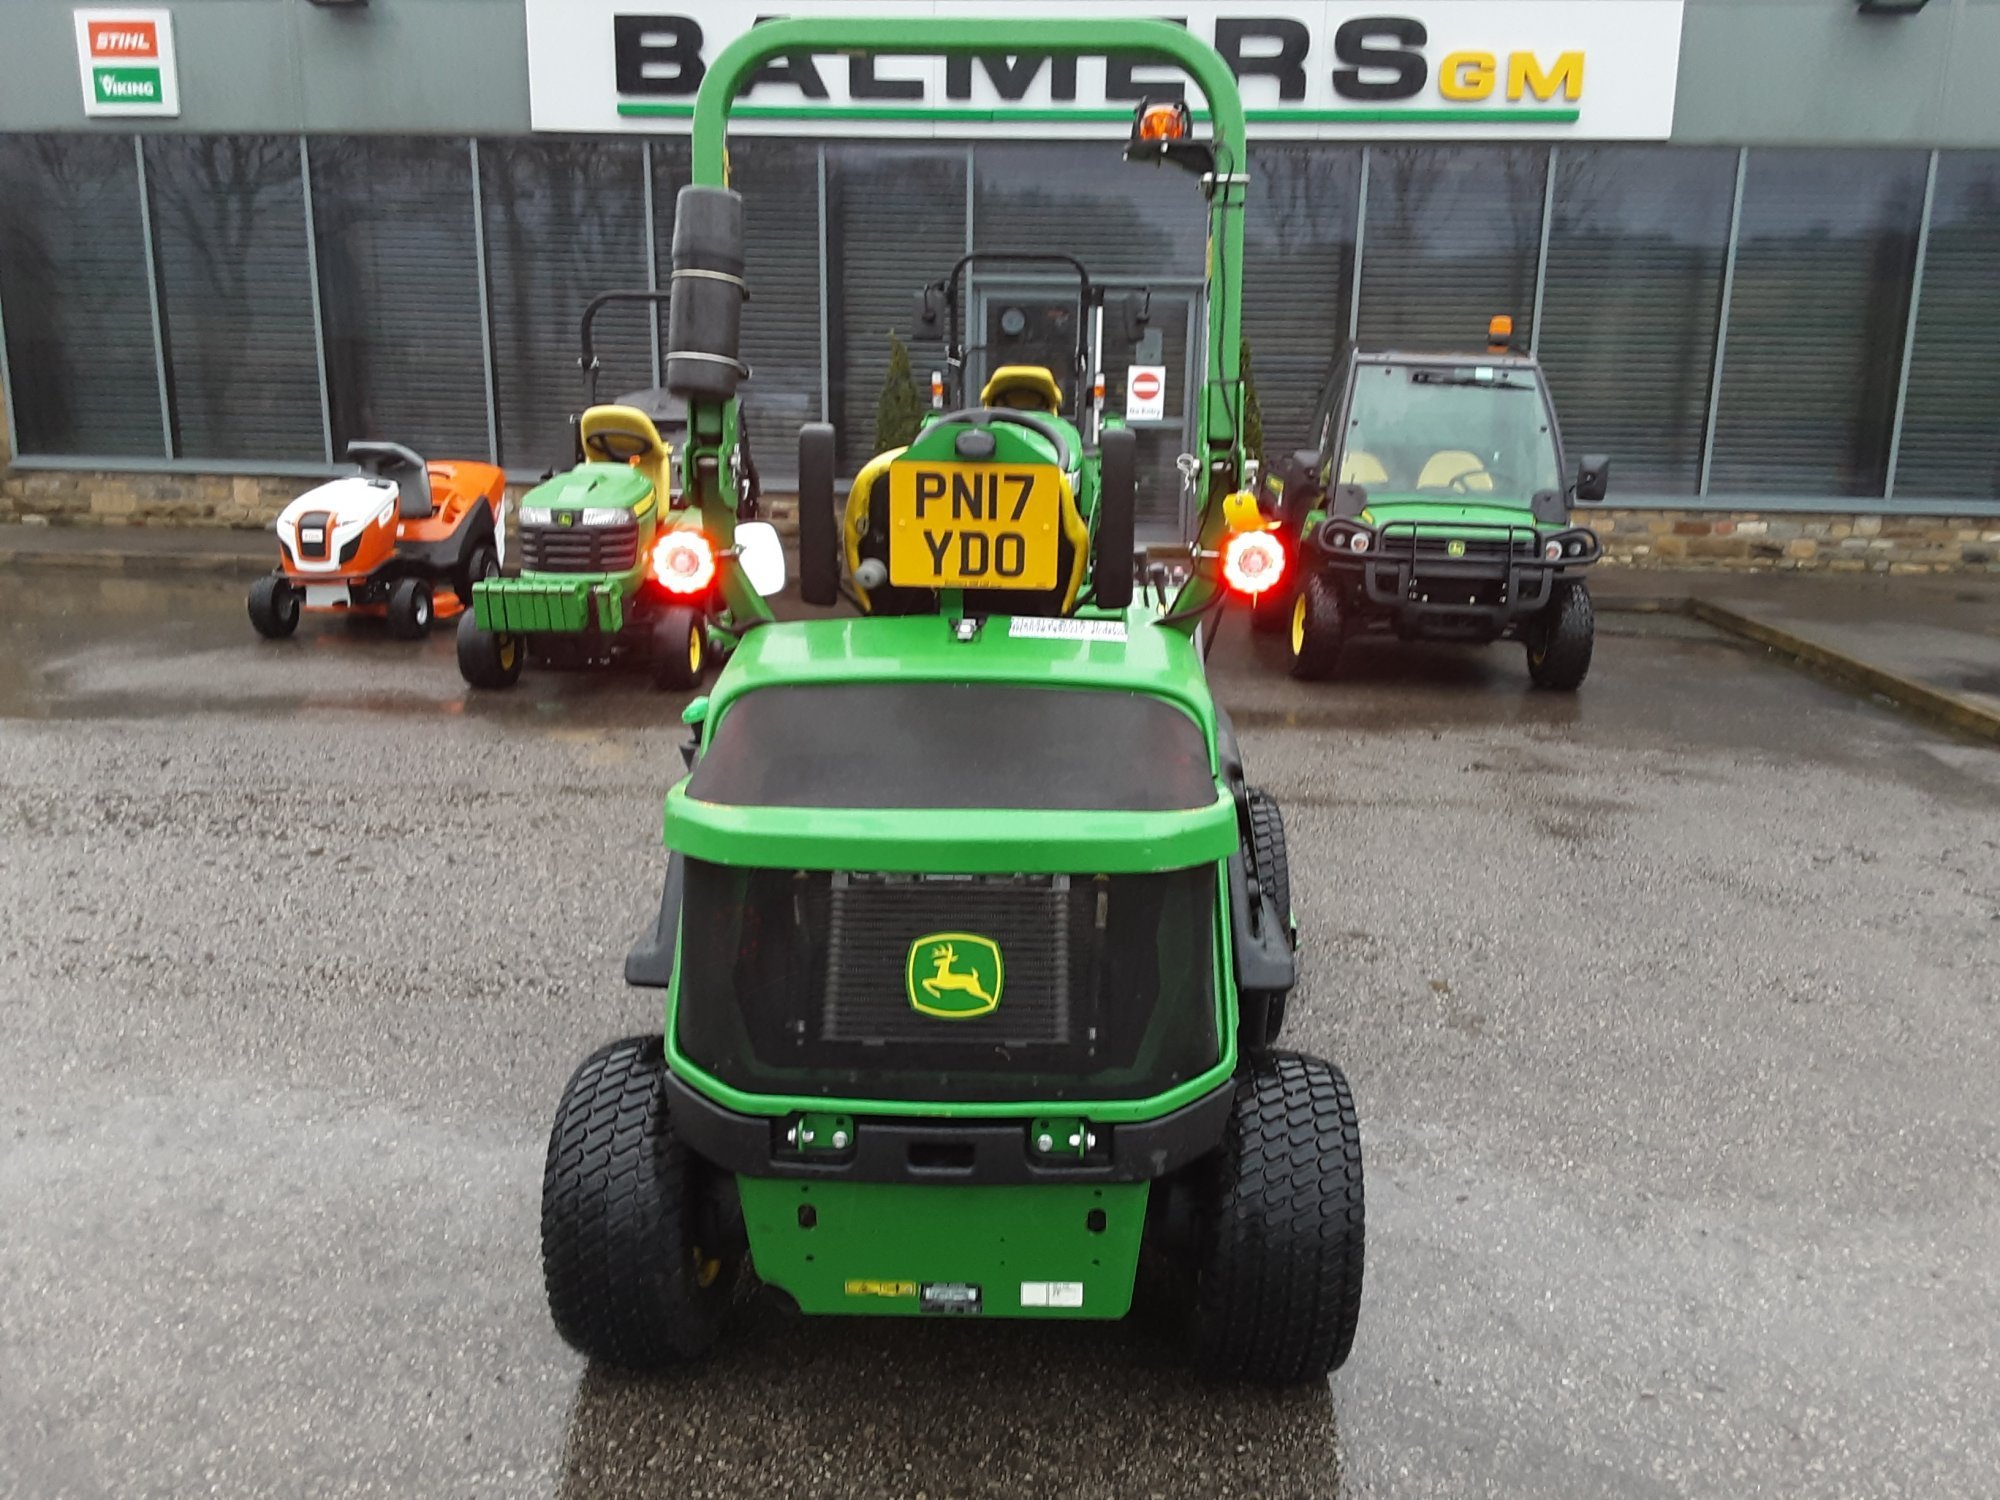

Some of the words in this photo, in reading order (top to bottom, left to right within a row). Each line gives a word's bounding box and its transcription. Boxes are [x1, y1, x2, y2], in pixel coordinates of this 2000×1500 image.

[96, 31, 150, 51] STIHL
[613, 14, 1428, 102] BALMERS
[1438, 51, 1585, 101] GM
[915, 472, 1035, 522] PN17
[923, 529, 1026, 577] YDO
